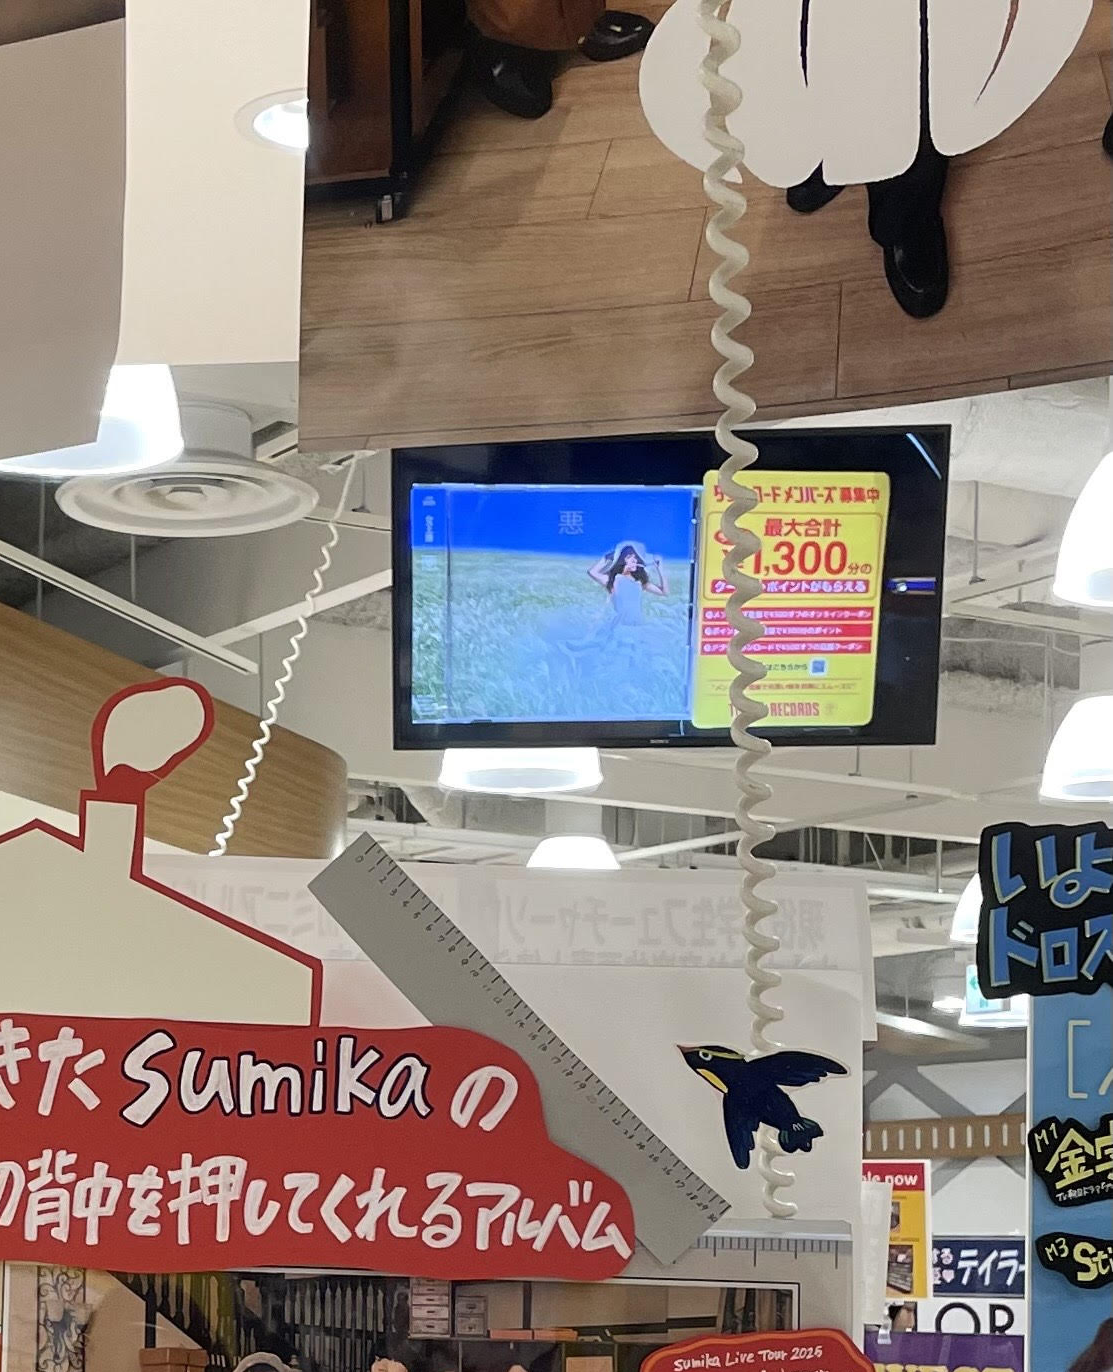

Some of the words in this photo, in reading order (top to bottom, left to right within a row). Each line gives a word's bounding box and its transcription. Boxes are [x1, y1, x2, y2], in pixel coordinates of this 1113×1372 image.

[764, 518, 842, 537] 最大合計
[770, 702, 819, 717] RECORDS
[450, 1065, 518, 1130] の
[1045, 1237, 1069, 1261] M3
[725, 1351, 754, 1367] Live
